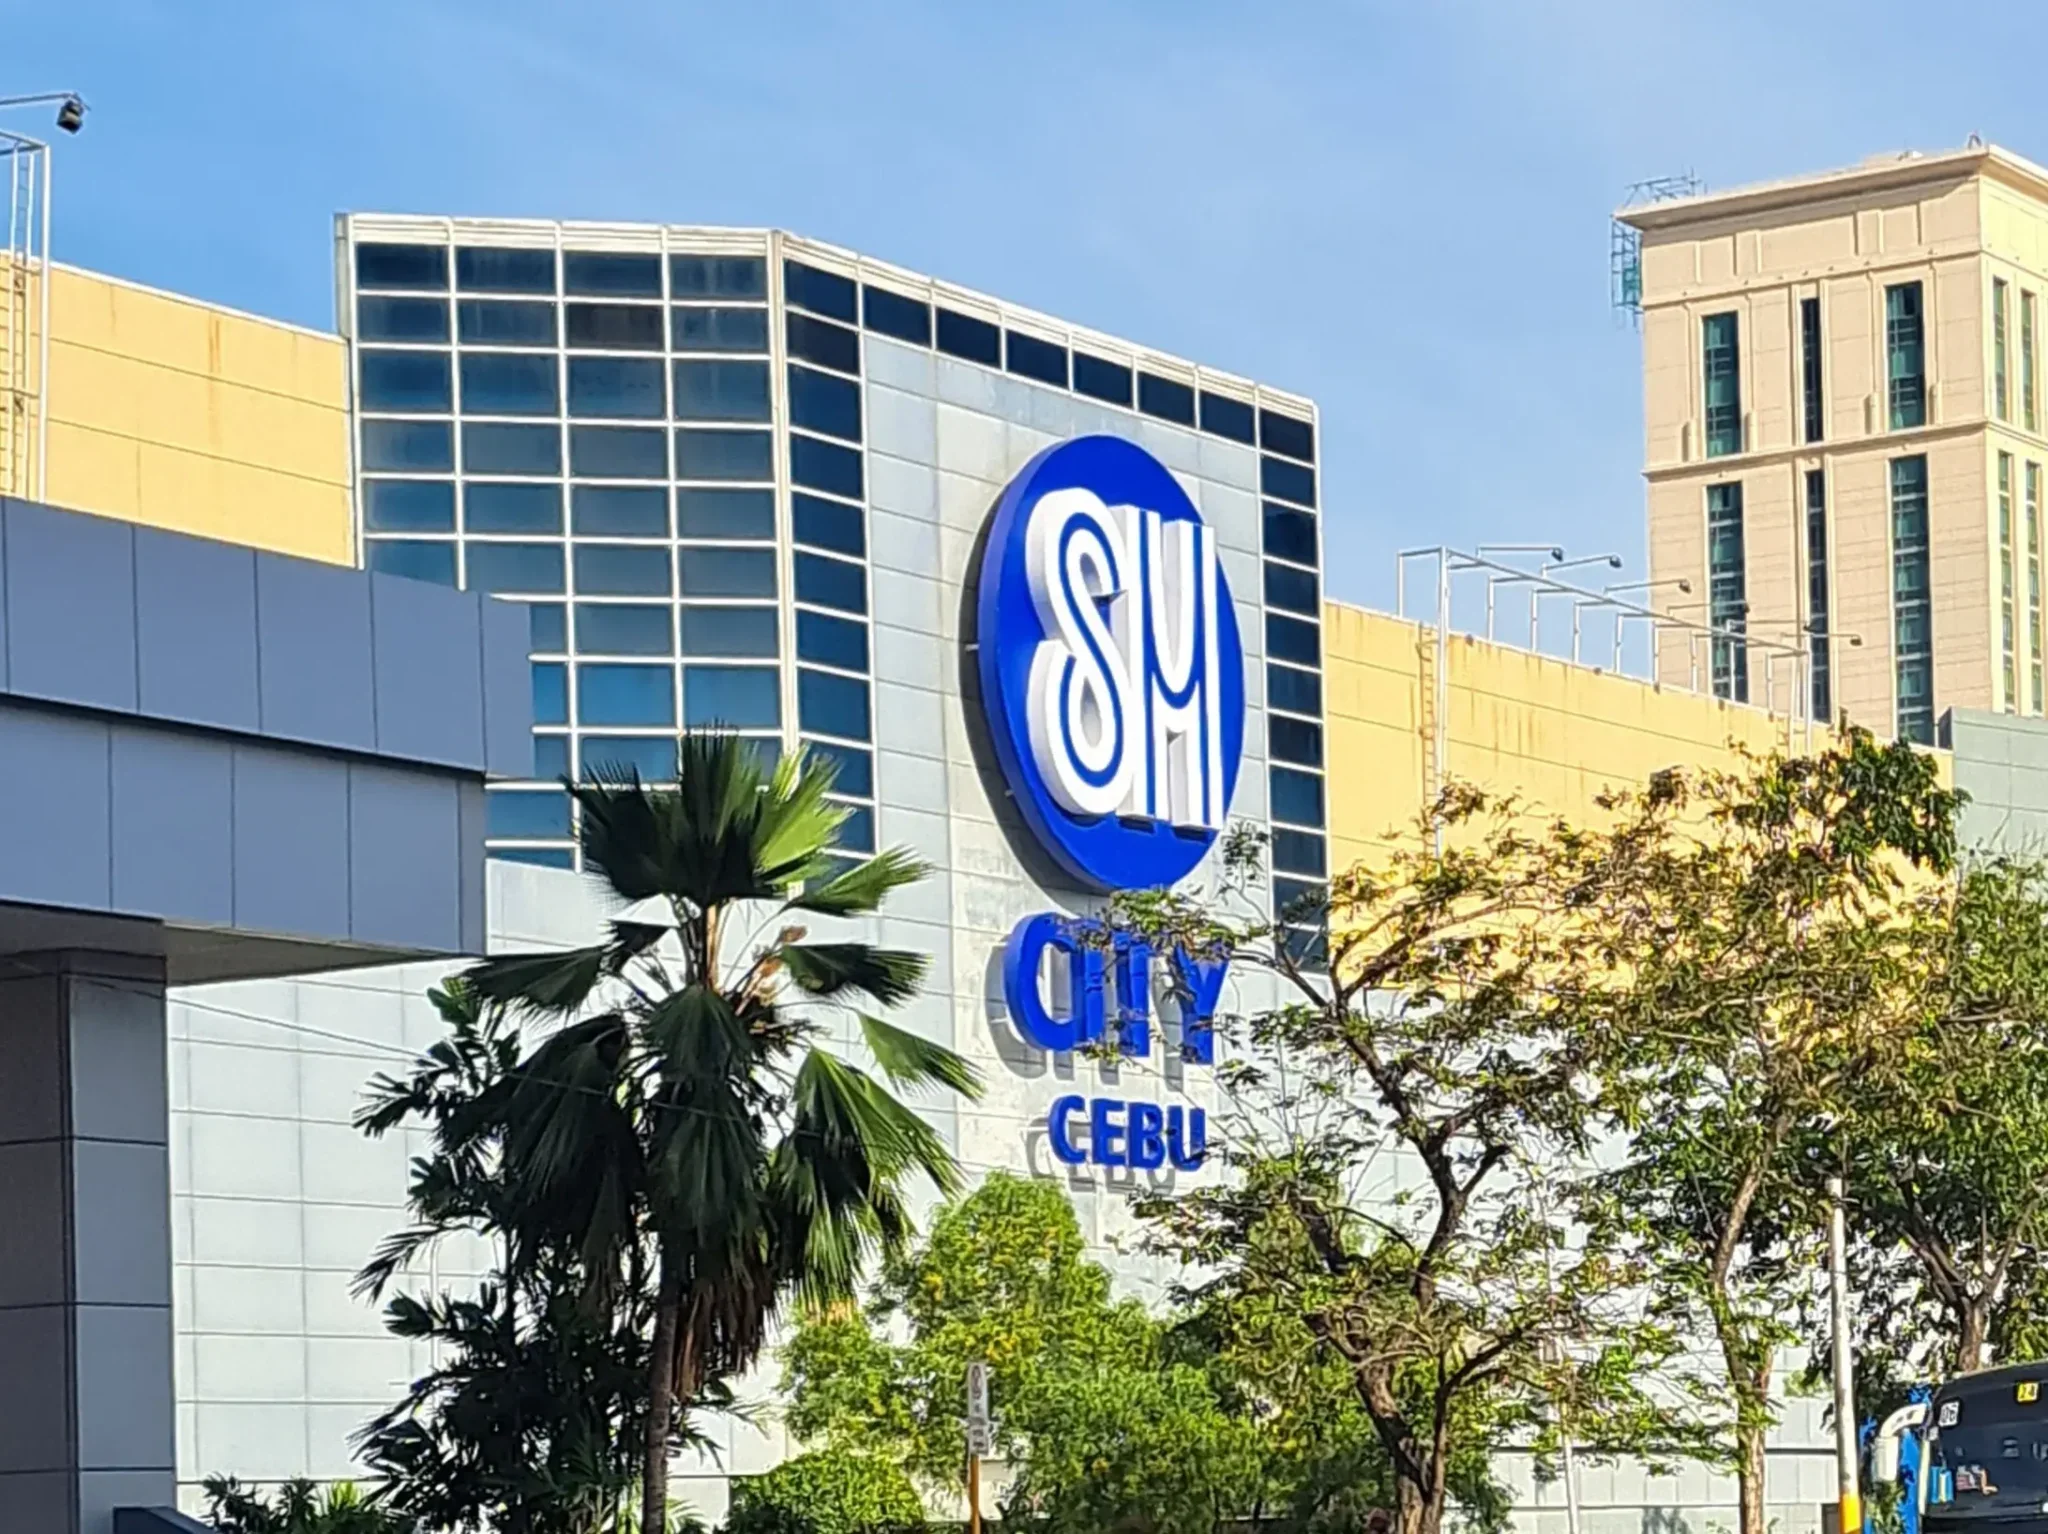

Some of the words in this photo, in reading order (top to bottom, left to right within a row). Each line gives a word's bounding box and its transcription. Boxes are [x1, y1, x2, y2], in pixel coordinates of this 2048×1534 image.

[1025, 487, 1223, 831] SM
[1004, 912, 1230, 1064] CITY
[1049, 1095, 1206, 1171] CEBU
